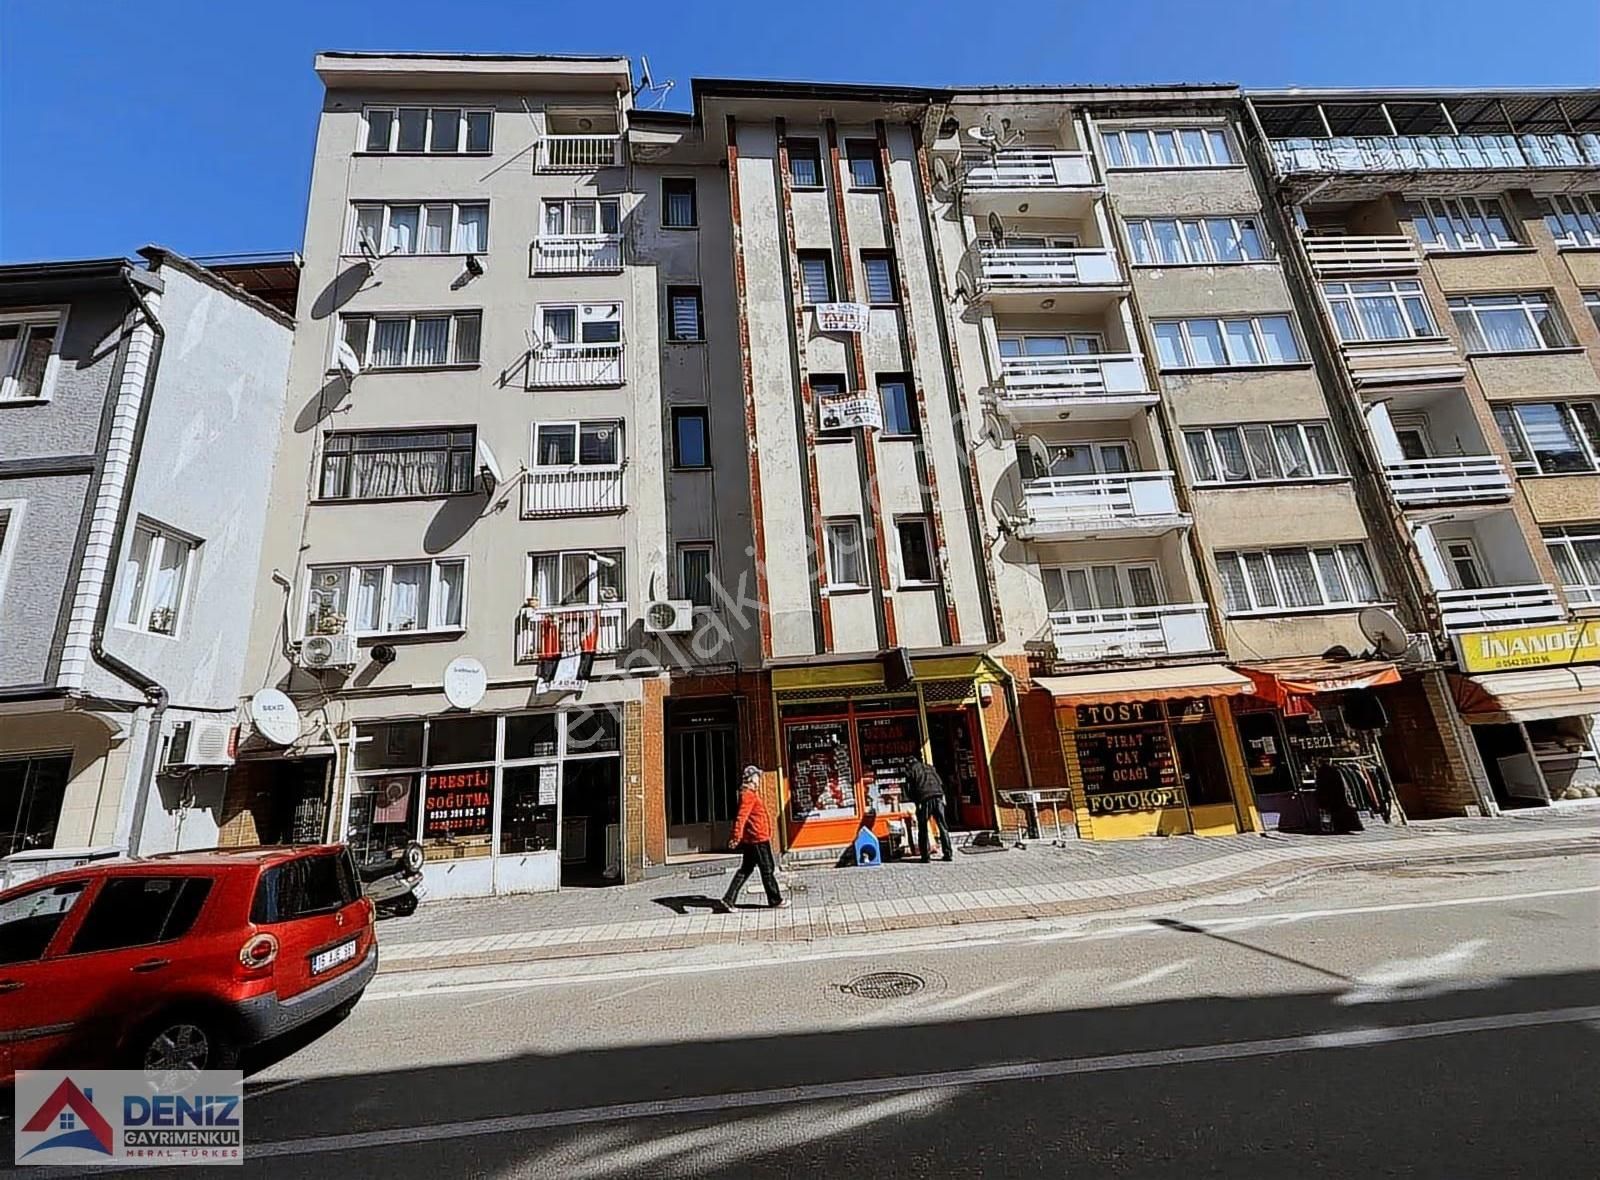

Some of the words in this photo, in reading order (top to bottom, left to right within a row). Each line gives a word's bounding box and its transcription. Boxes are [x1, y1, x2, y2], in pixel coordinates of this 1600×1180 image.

[1088, 703, 1144, 723] TOST
[429, 769, 489, 789] PRESTİJ
[426, 791, 490, 810] SOĞUTMA
